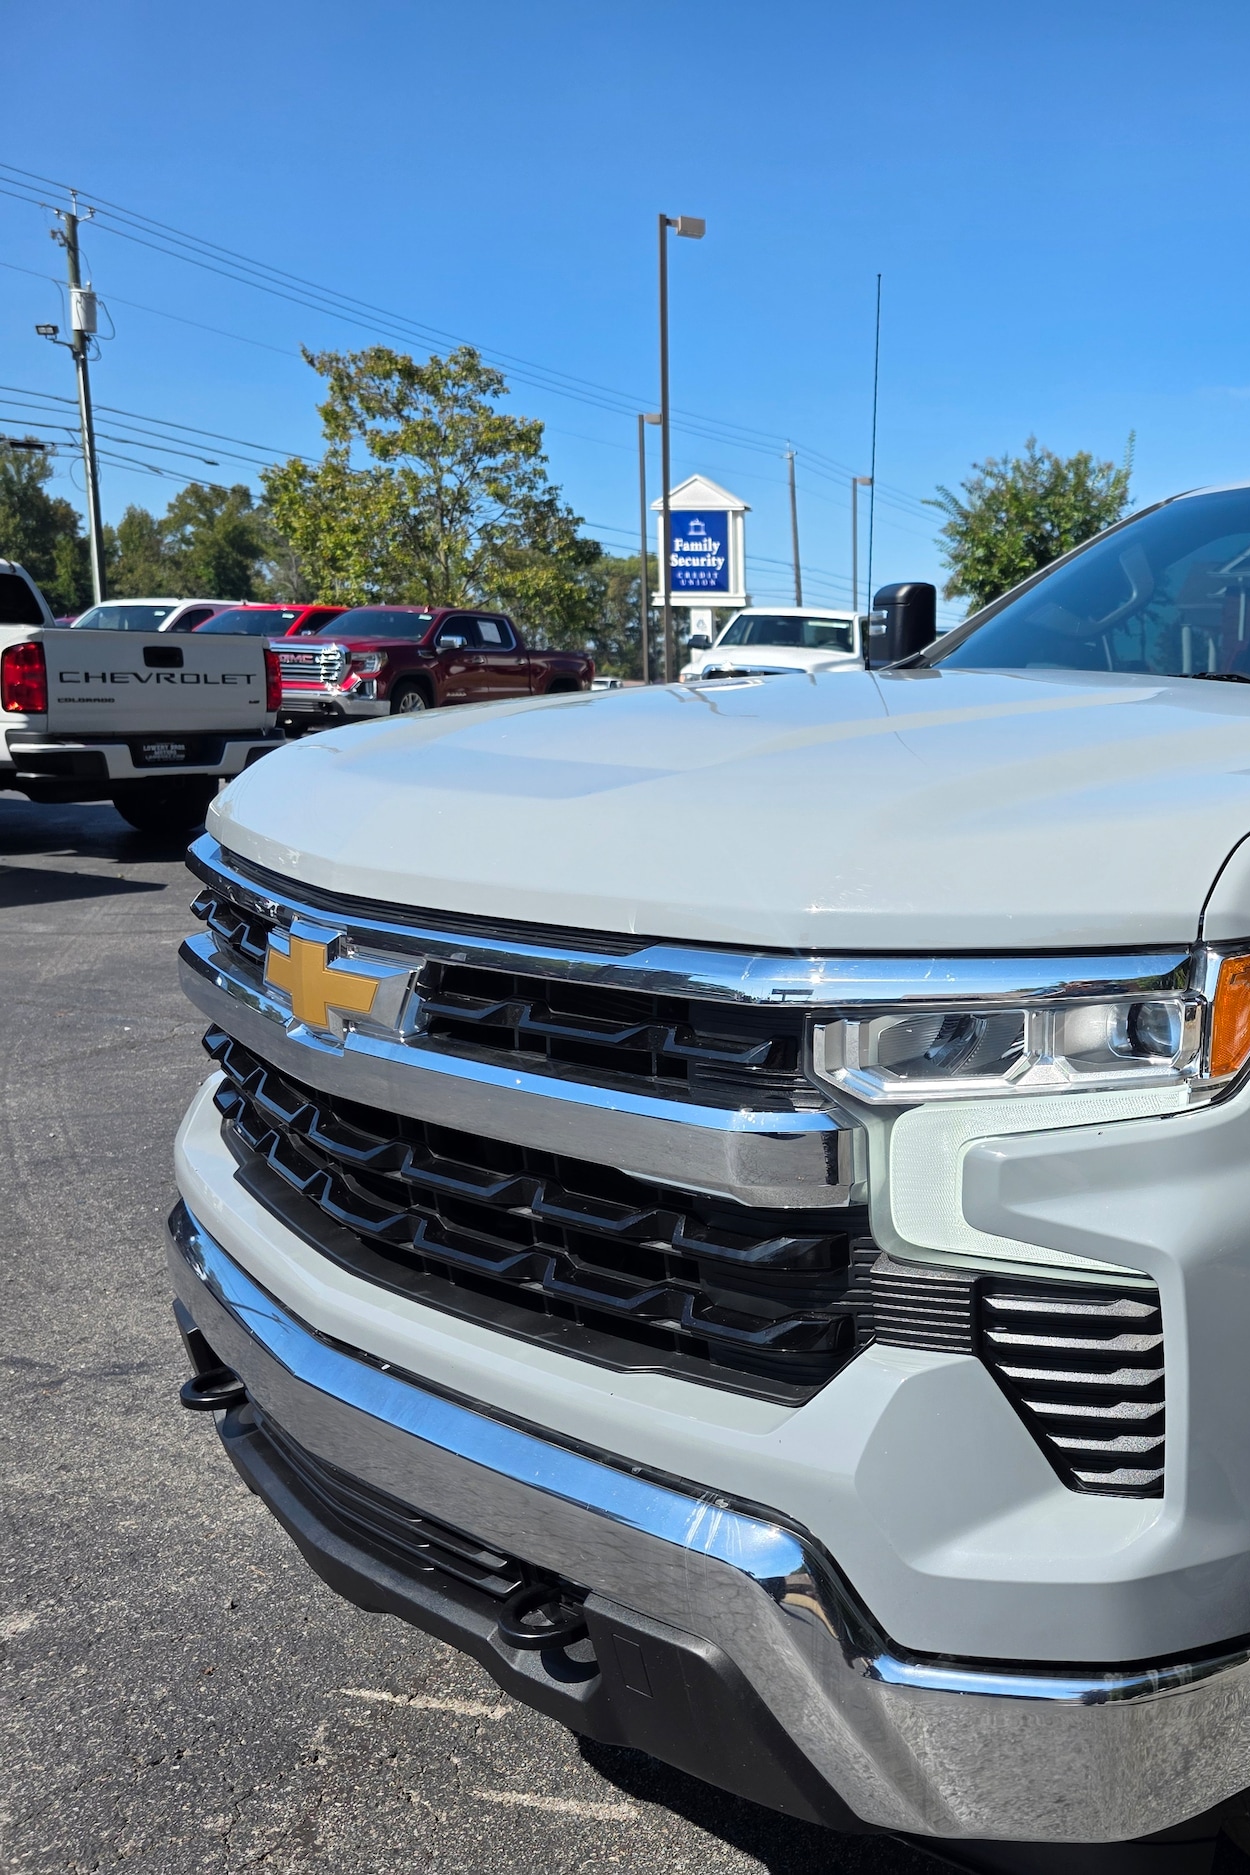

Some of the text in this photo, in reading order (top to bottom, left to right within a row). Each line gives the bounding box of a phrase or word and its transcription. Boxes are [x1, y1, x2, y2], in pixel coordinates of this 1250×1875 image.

[674, 538, 720, 555] Family
[670, 553, 725, 570] Security
[677, 571, 718, 579] CREDIT
[279, 654, 313, 663] GMC
[59, 671, 256, 685] CHEVROLET
